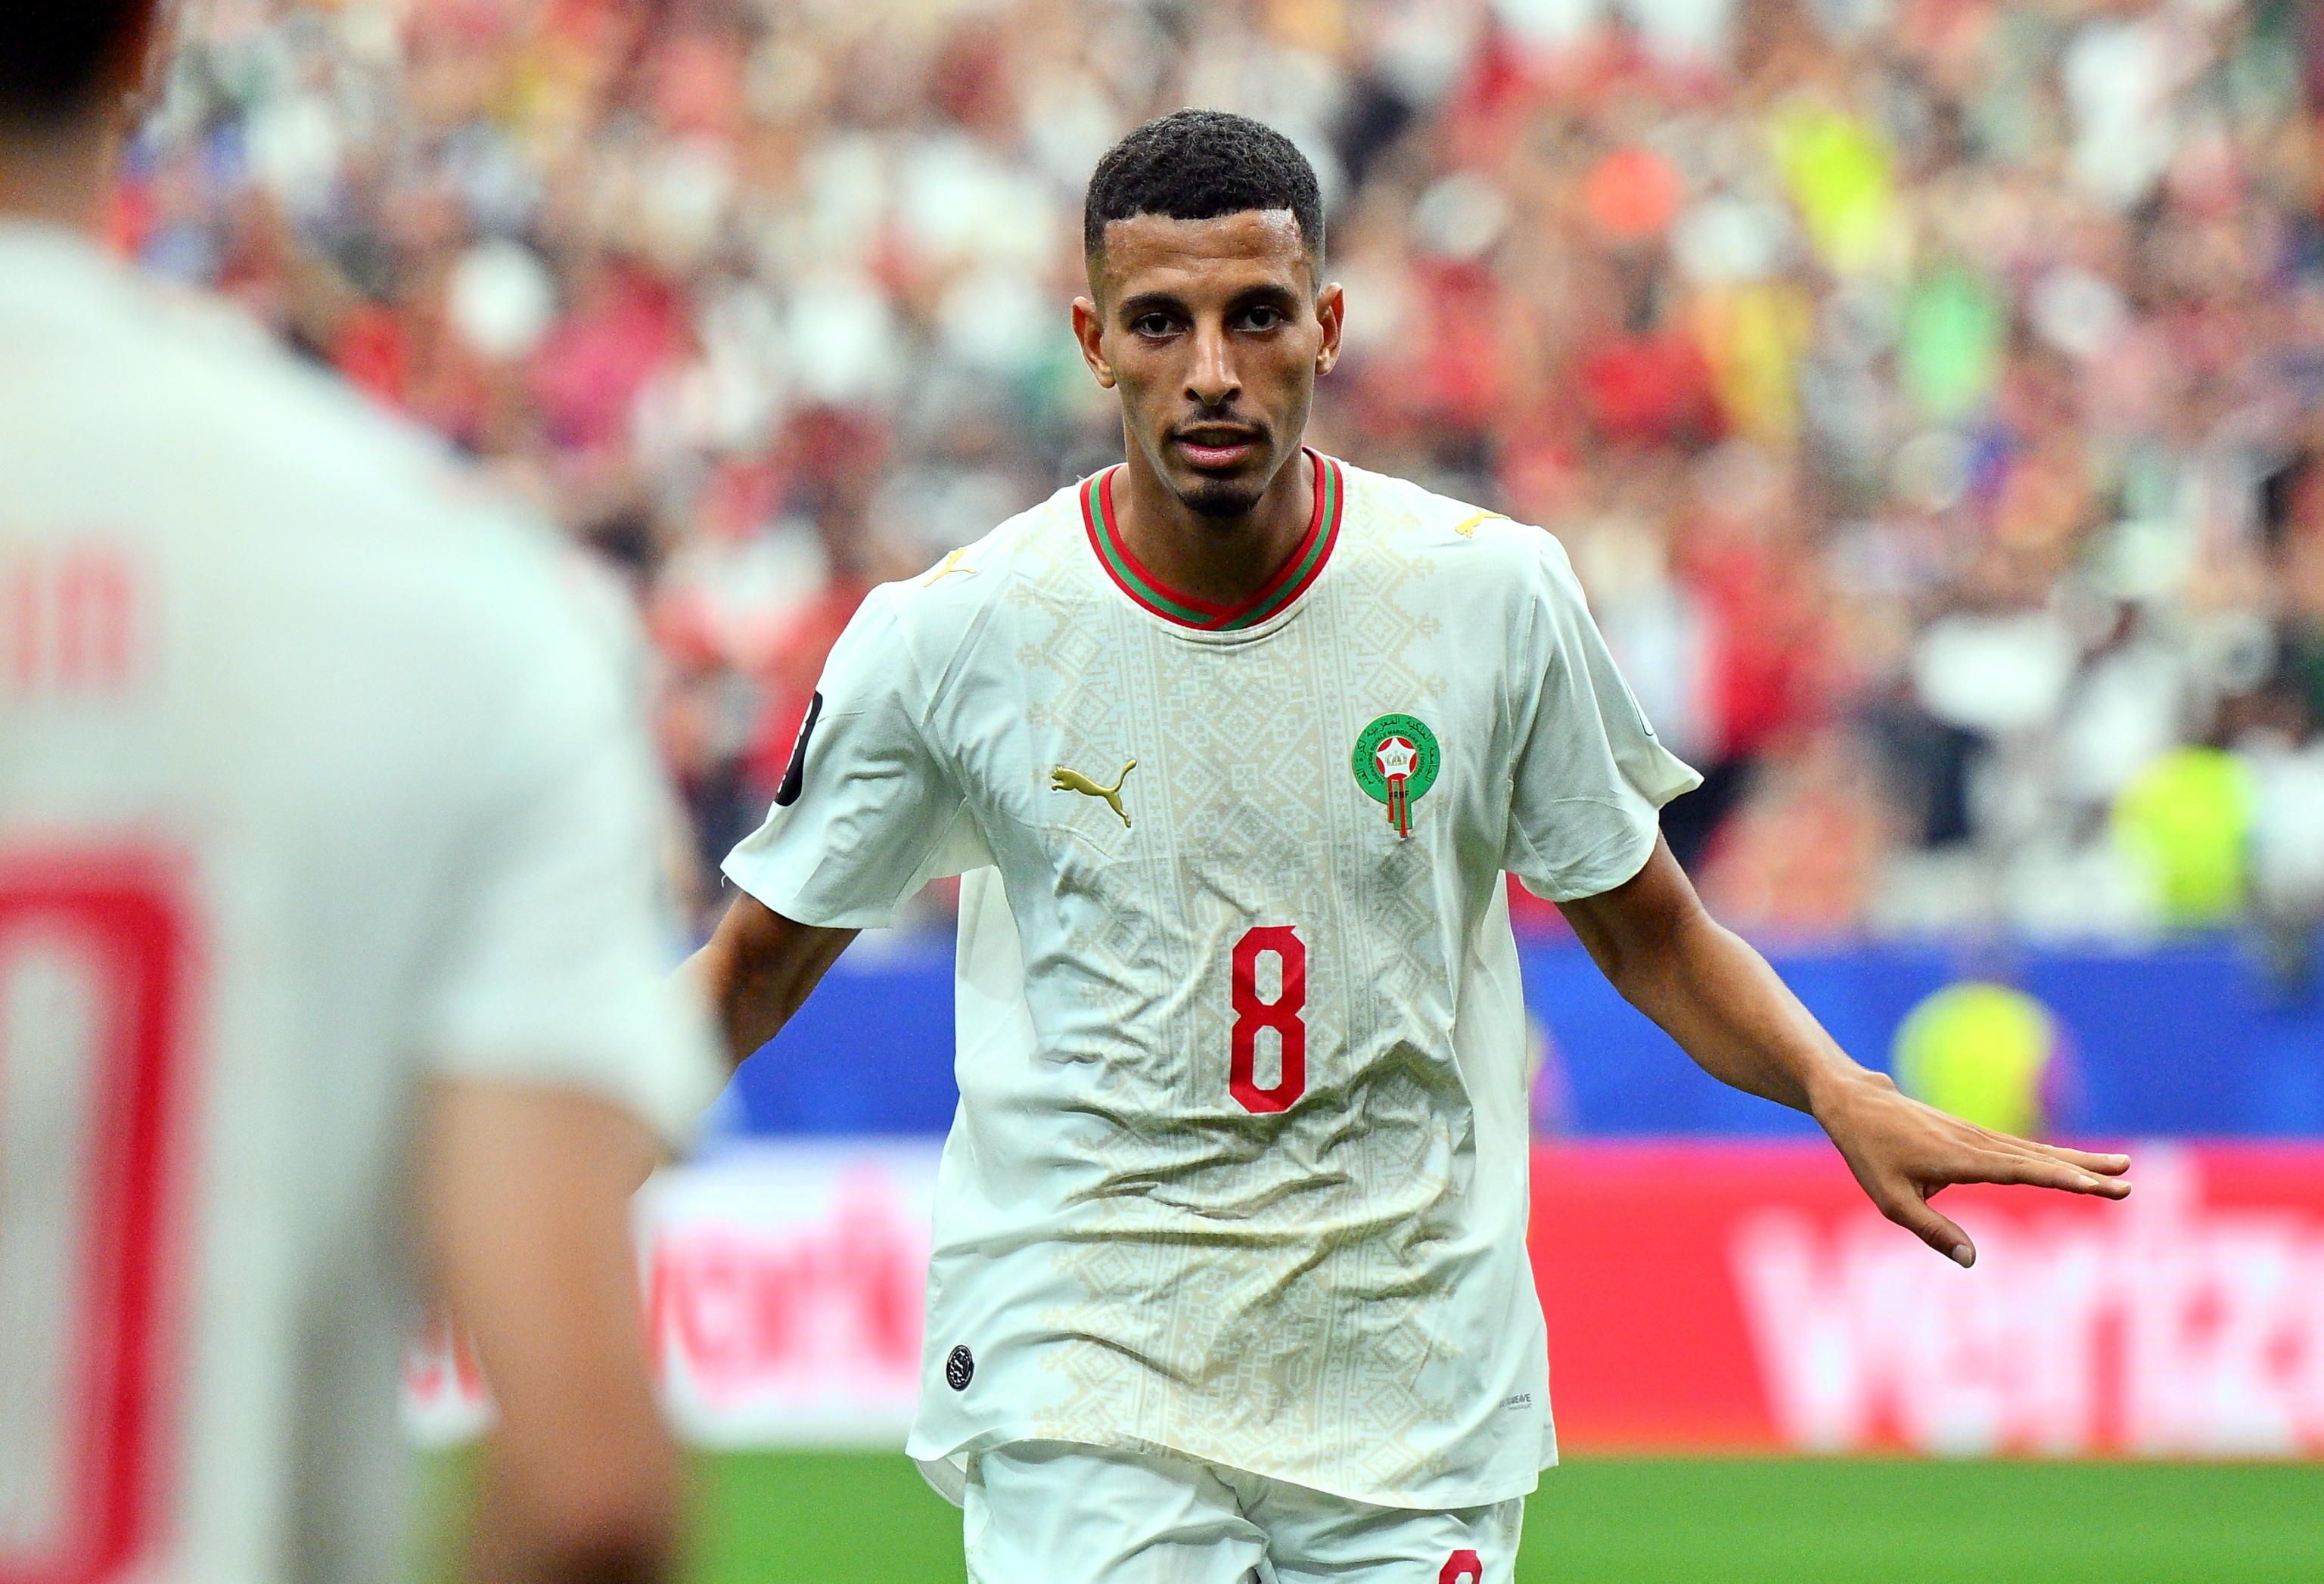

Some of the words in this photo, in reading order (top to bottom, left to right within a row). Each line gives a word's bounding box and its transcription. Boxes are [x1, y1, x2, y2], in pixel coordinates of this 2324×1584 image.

[1363, 716, 1400, 737] المغربية
[1406, 717, 1433, 742] الملكية
[1425, 746, 1437, 784] الجامعة
[1229, 925, 1307, 1113] 8
